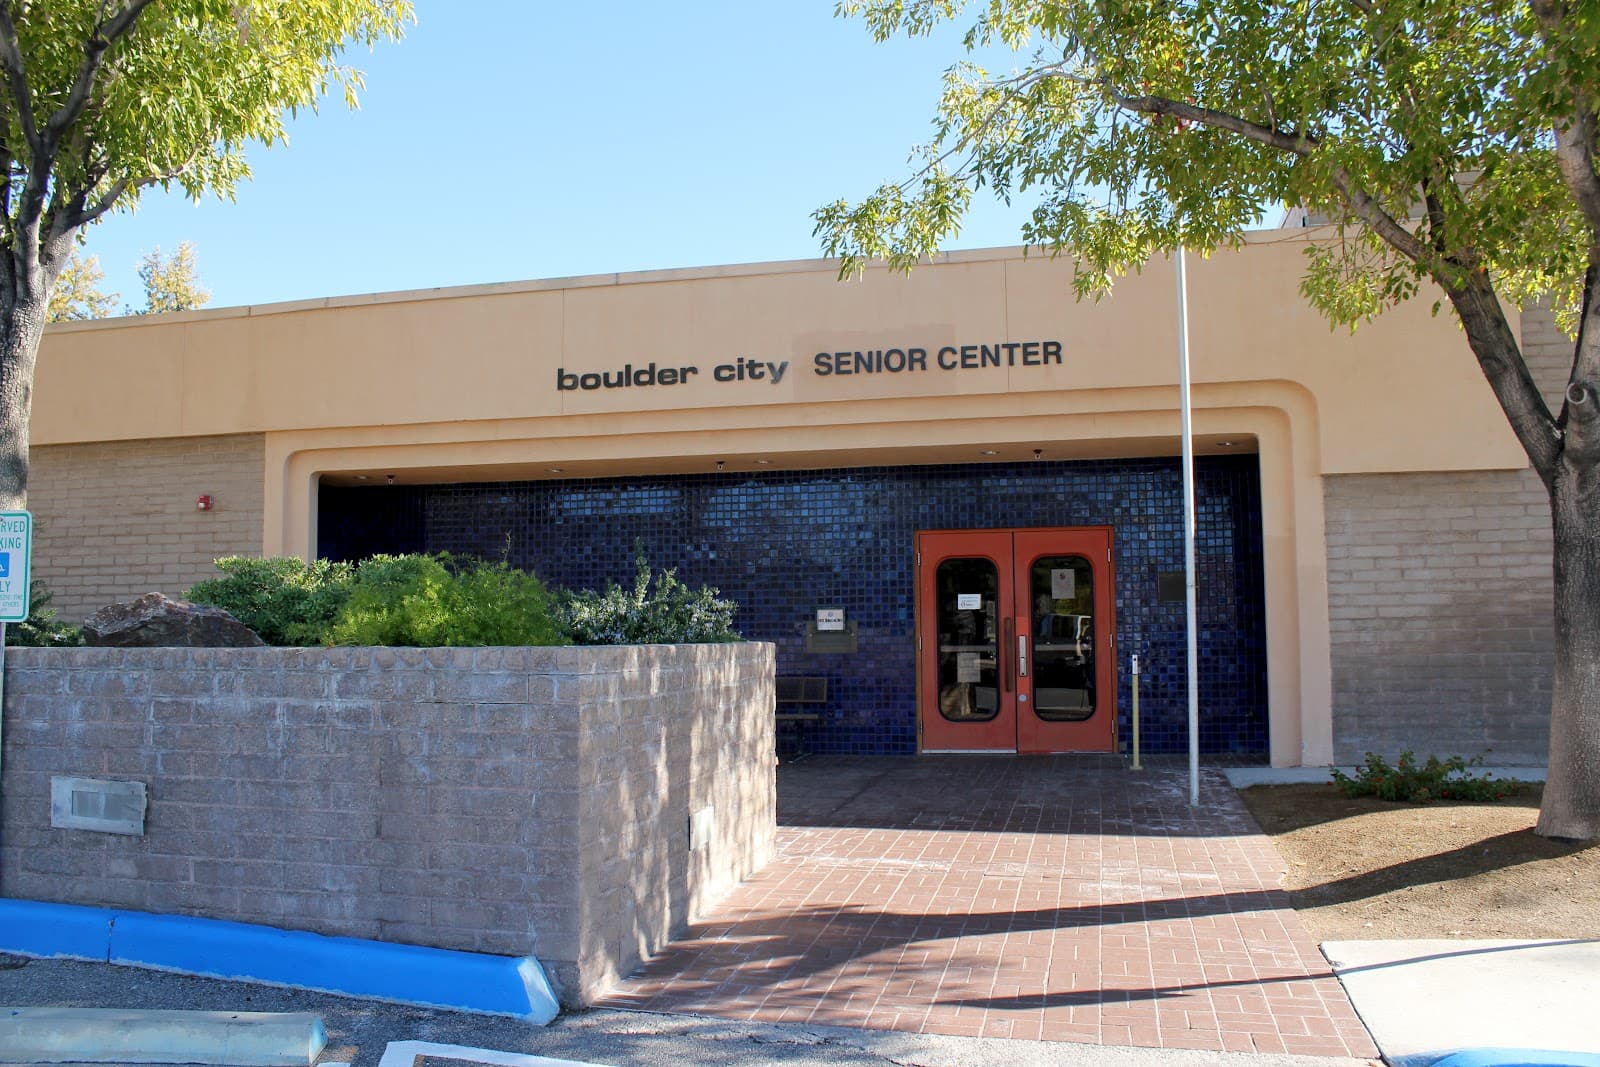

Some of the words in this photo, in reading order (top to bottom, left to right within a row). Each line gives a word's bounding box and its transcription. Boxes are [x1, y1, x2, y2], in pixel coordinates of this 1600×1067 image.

[557, 362, 699, 391] boulder
[713, 357, 789, 385] city
[814, 347, 928, 376] SENIOR
[937, 340, 1063, 370] CENTER
